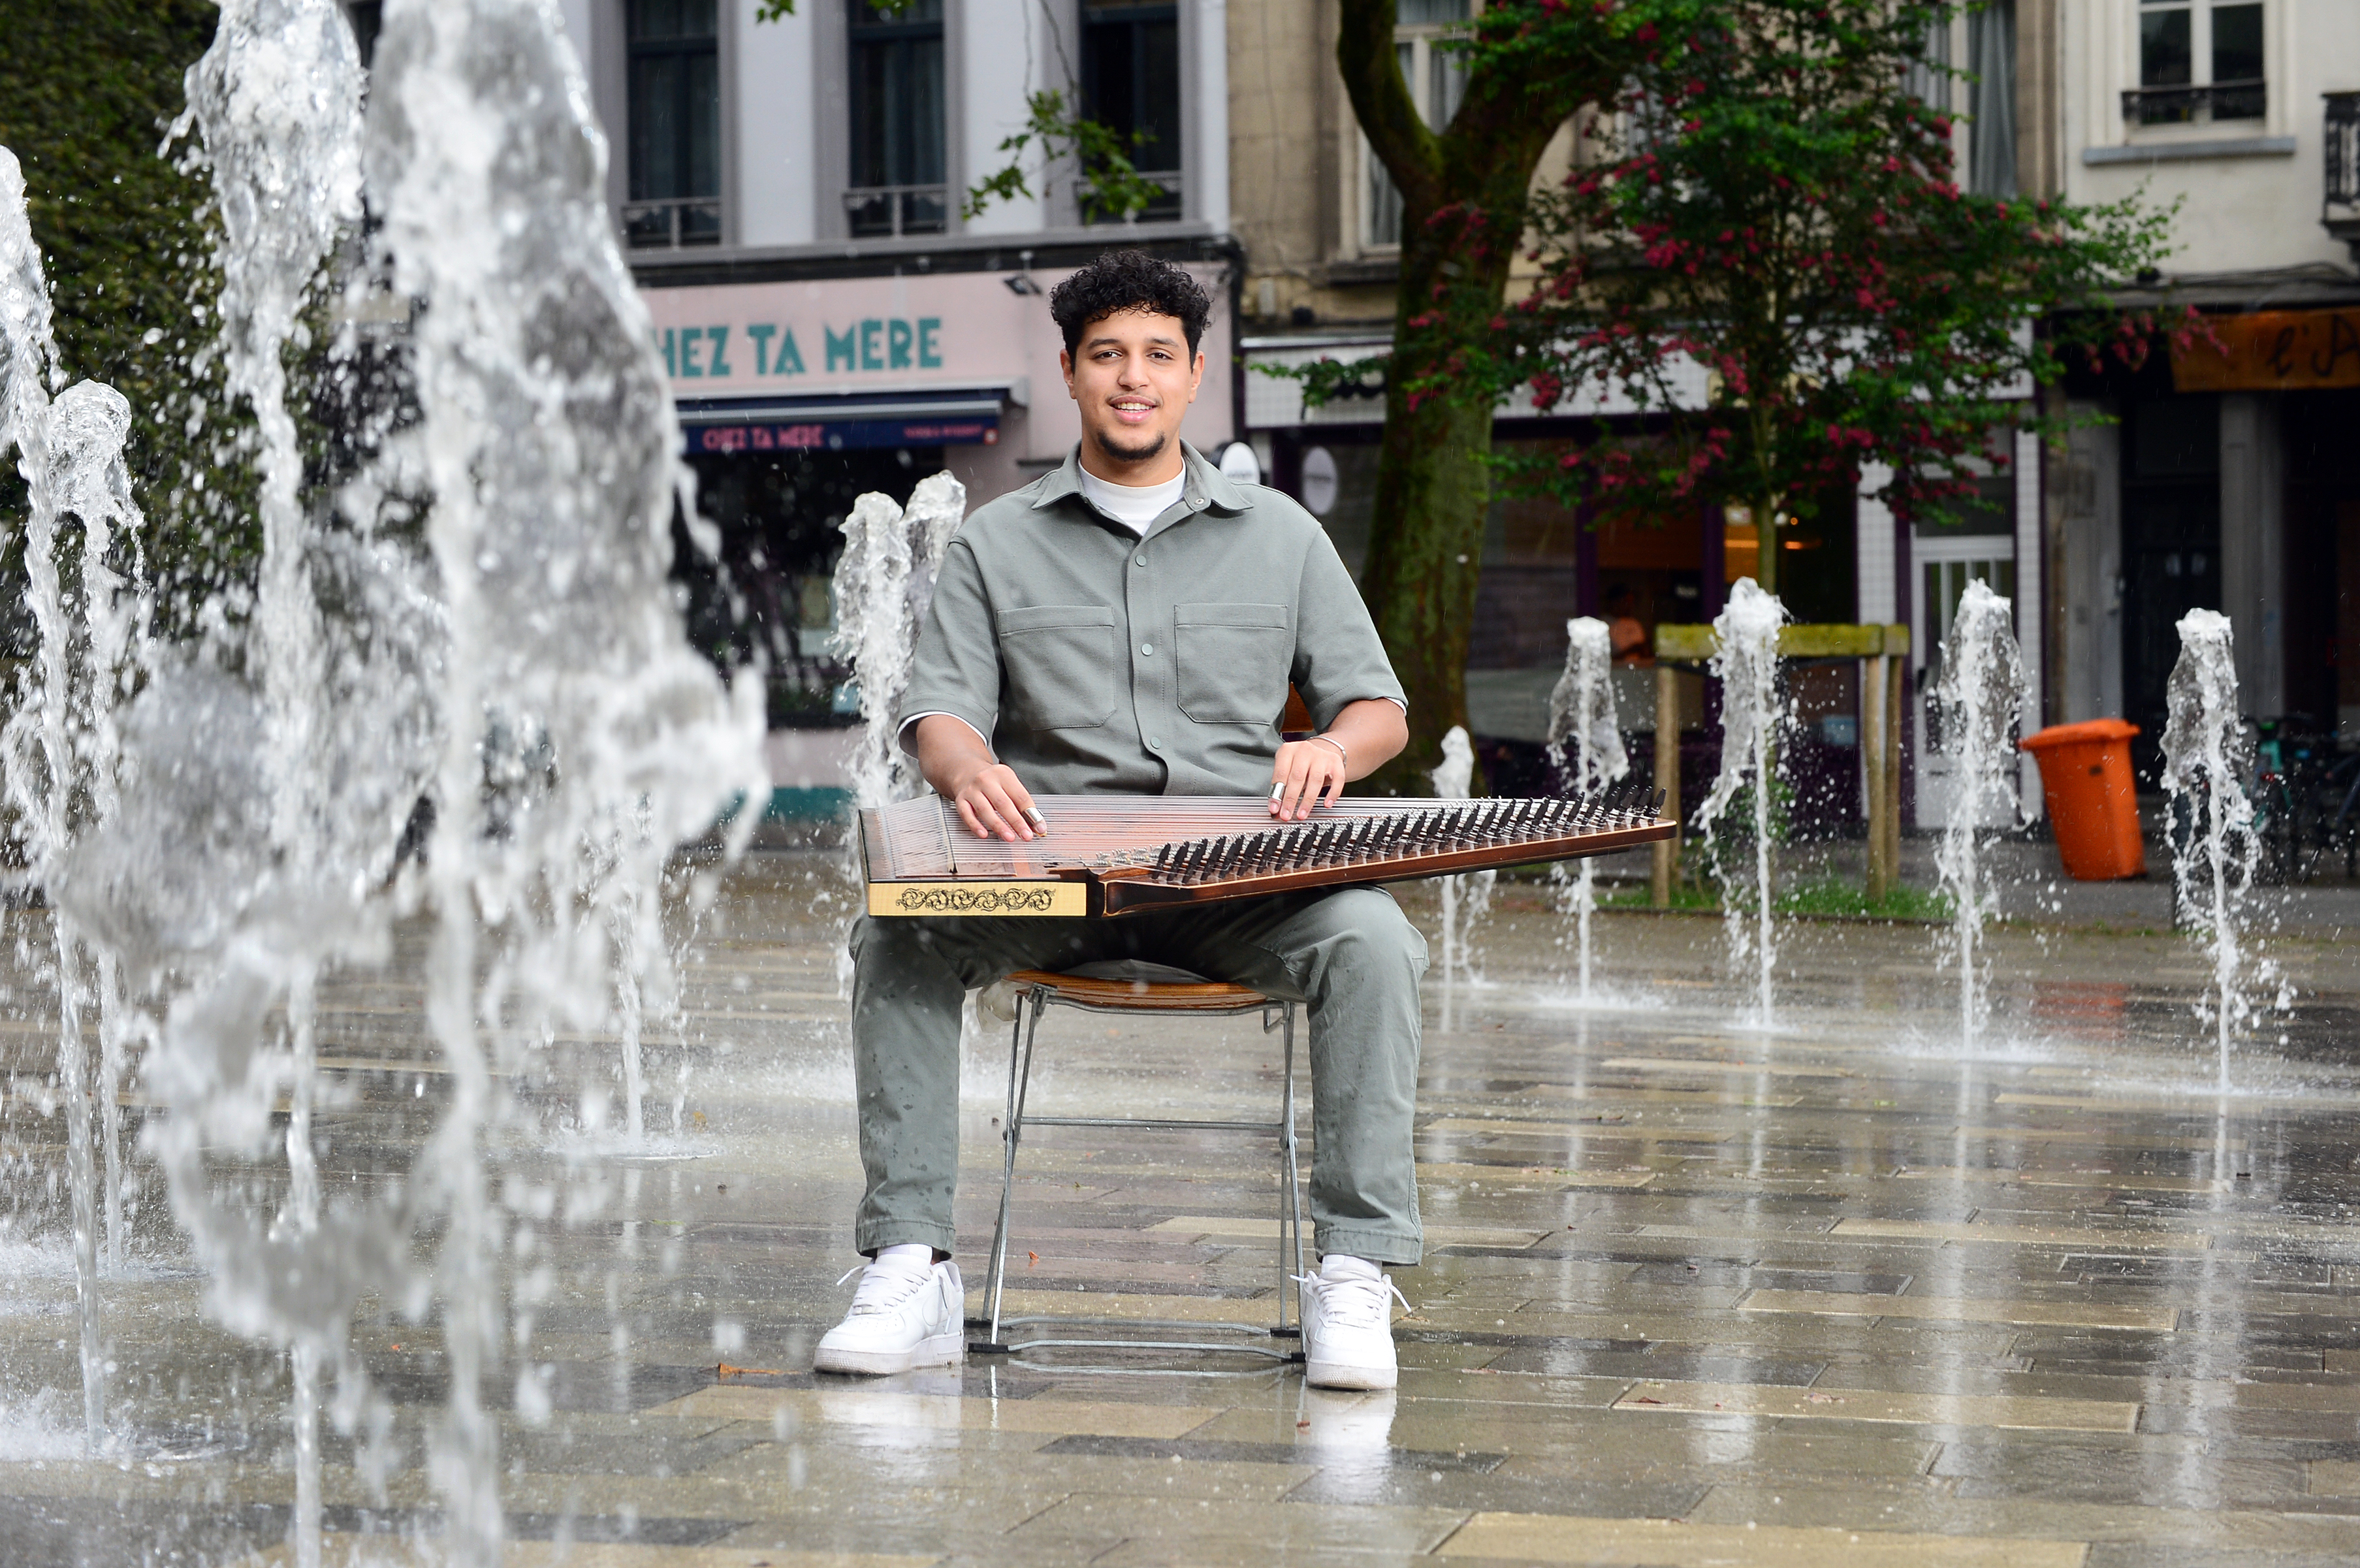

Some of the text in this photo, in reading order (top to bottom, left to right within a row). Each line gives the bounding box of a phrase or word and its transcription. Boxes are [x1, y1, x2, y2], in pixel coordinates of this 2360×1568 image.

[651, 318, 942, 378] HEZ TA MERE
[702, 426, 747, 451] CHEZ
[752, 426, 774, 449] TA
